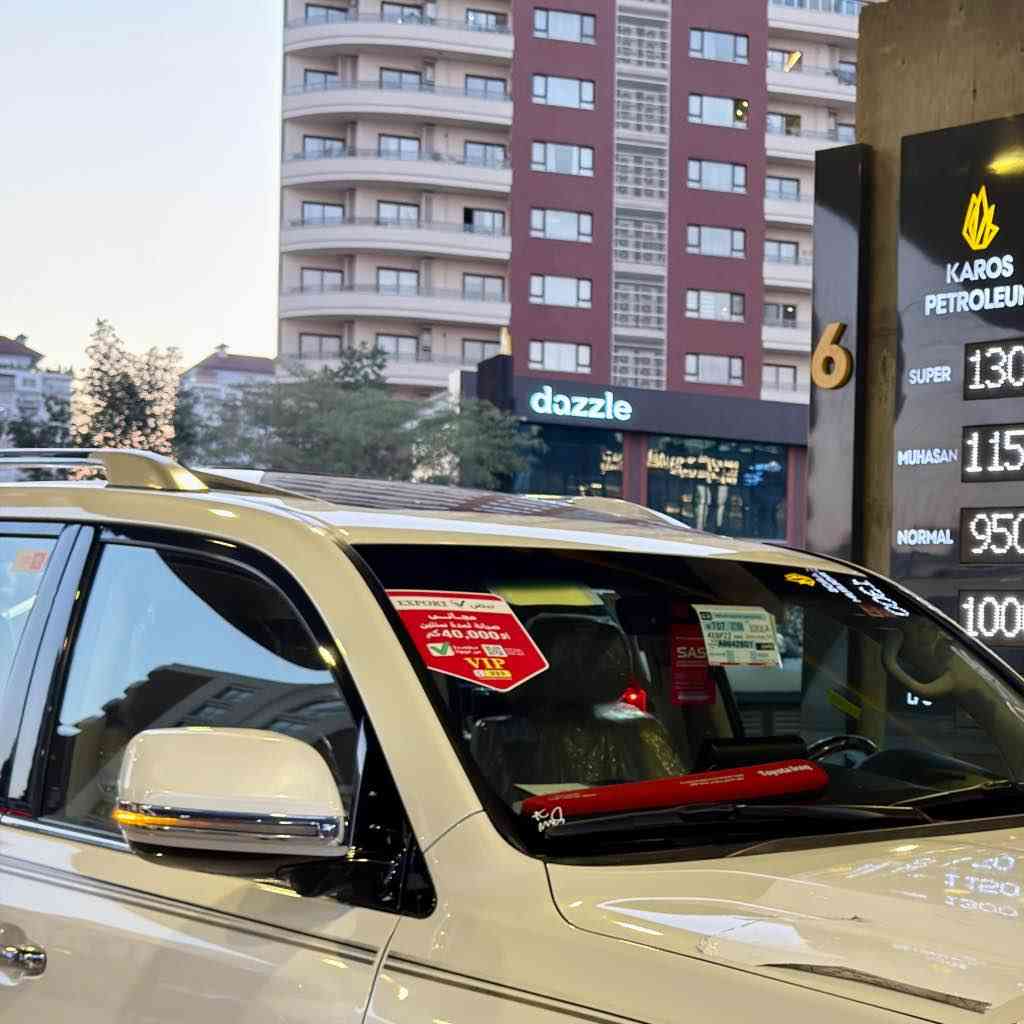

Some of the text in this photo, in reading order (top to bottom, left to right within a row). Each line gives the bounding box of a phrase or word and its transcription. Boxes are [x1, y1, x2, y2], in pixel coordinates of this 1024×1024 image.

[946, 254, 1014, 284] KAROS
[812, 322, 853, 390] 6
[909, 366, 951, 385] SUPER
[529, 385, 633, 422] dazzle
[897, 447, 957, 465] MUHASAN
[897, 529, 954, 546] NORMAL
